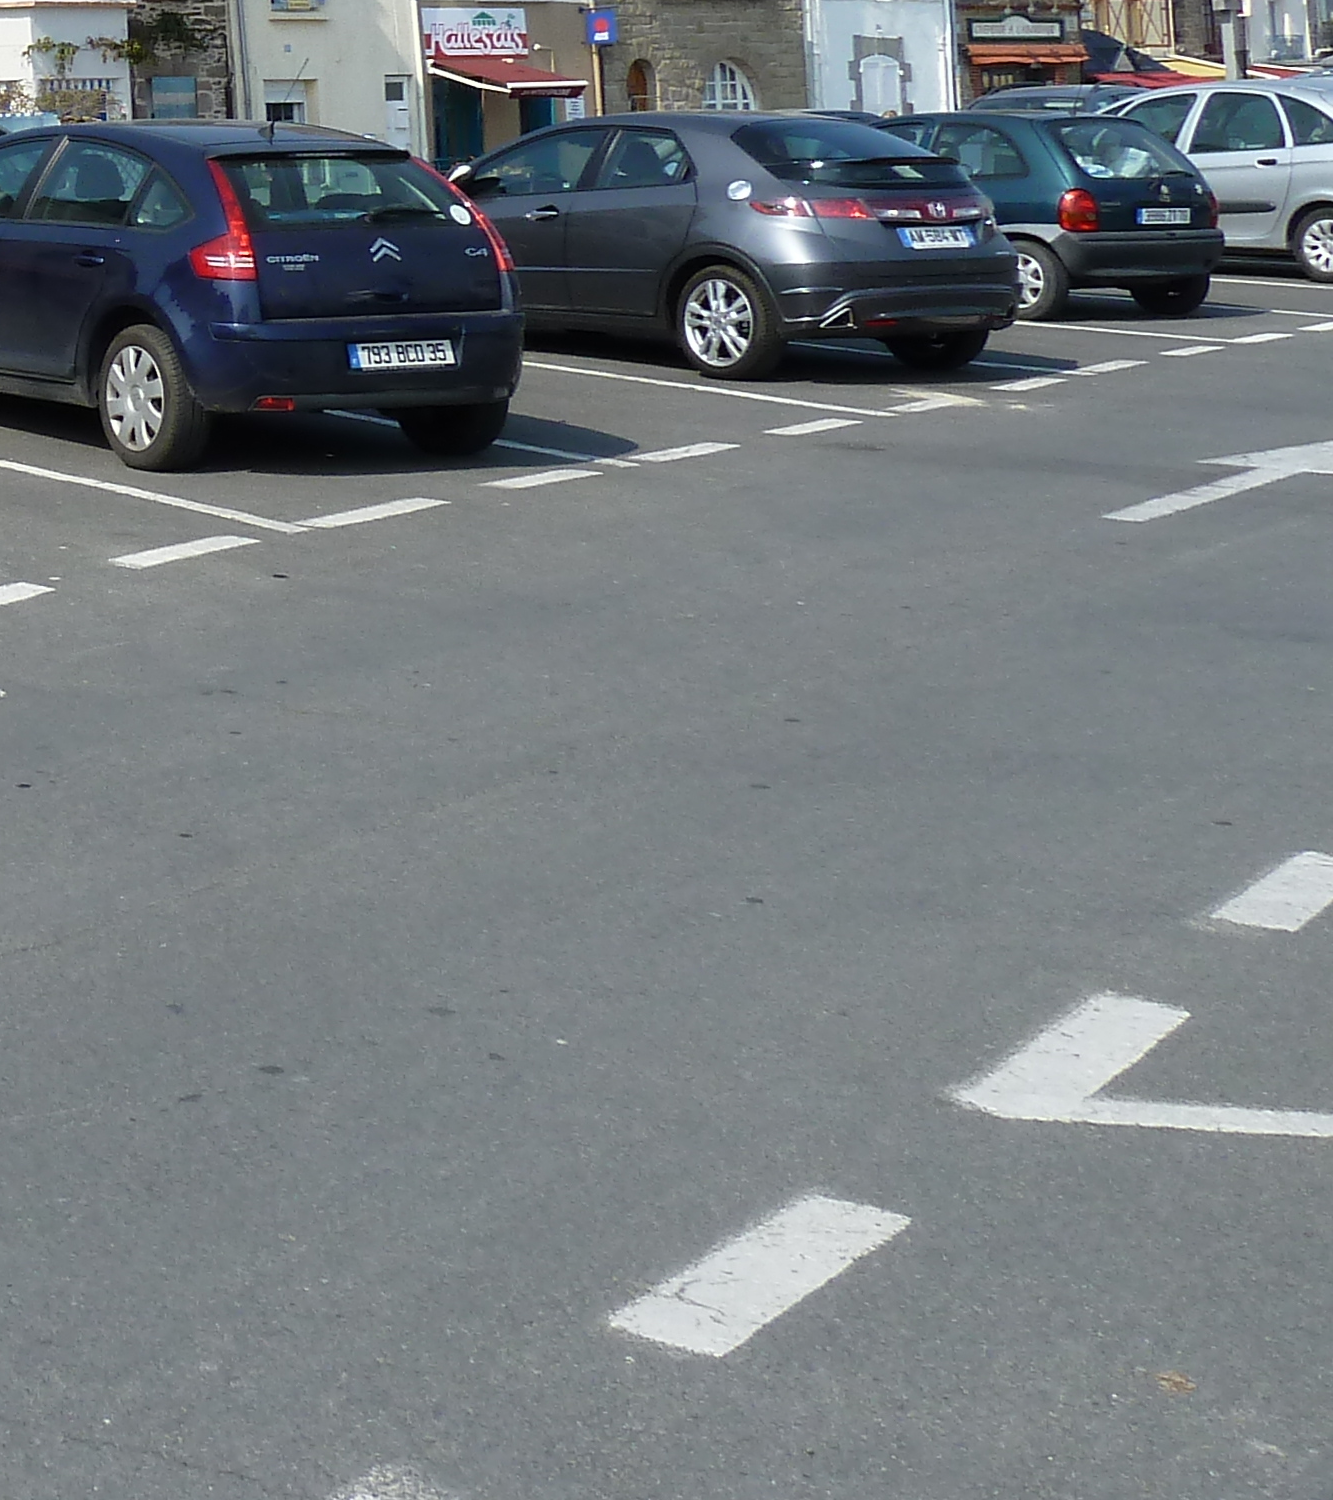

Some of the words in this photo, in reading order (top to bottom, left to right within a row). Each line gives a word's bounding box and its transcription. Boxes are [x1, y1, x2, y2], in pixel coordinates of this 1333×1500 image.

[464, 247, 489, 257] C4
[361, 345, 392, 365] 793
[427, 343, 447, 362] 35
